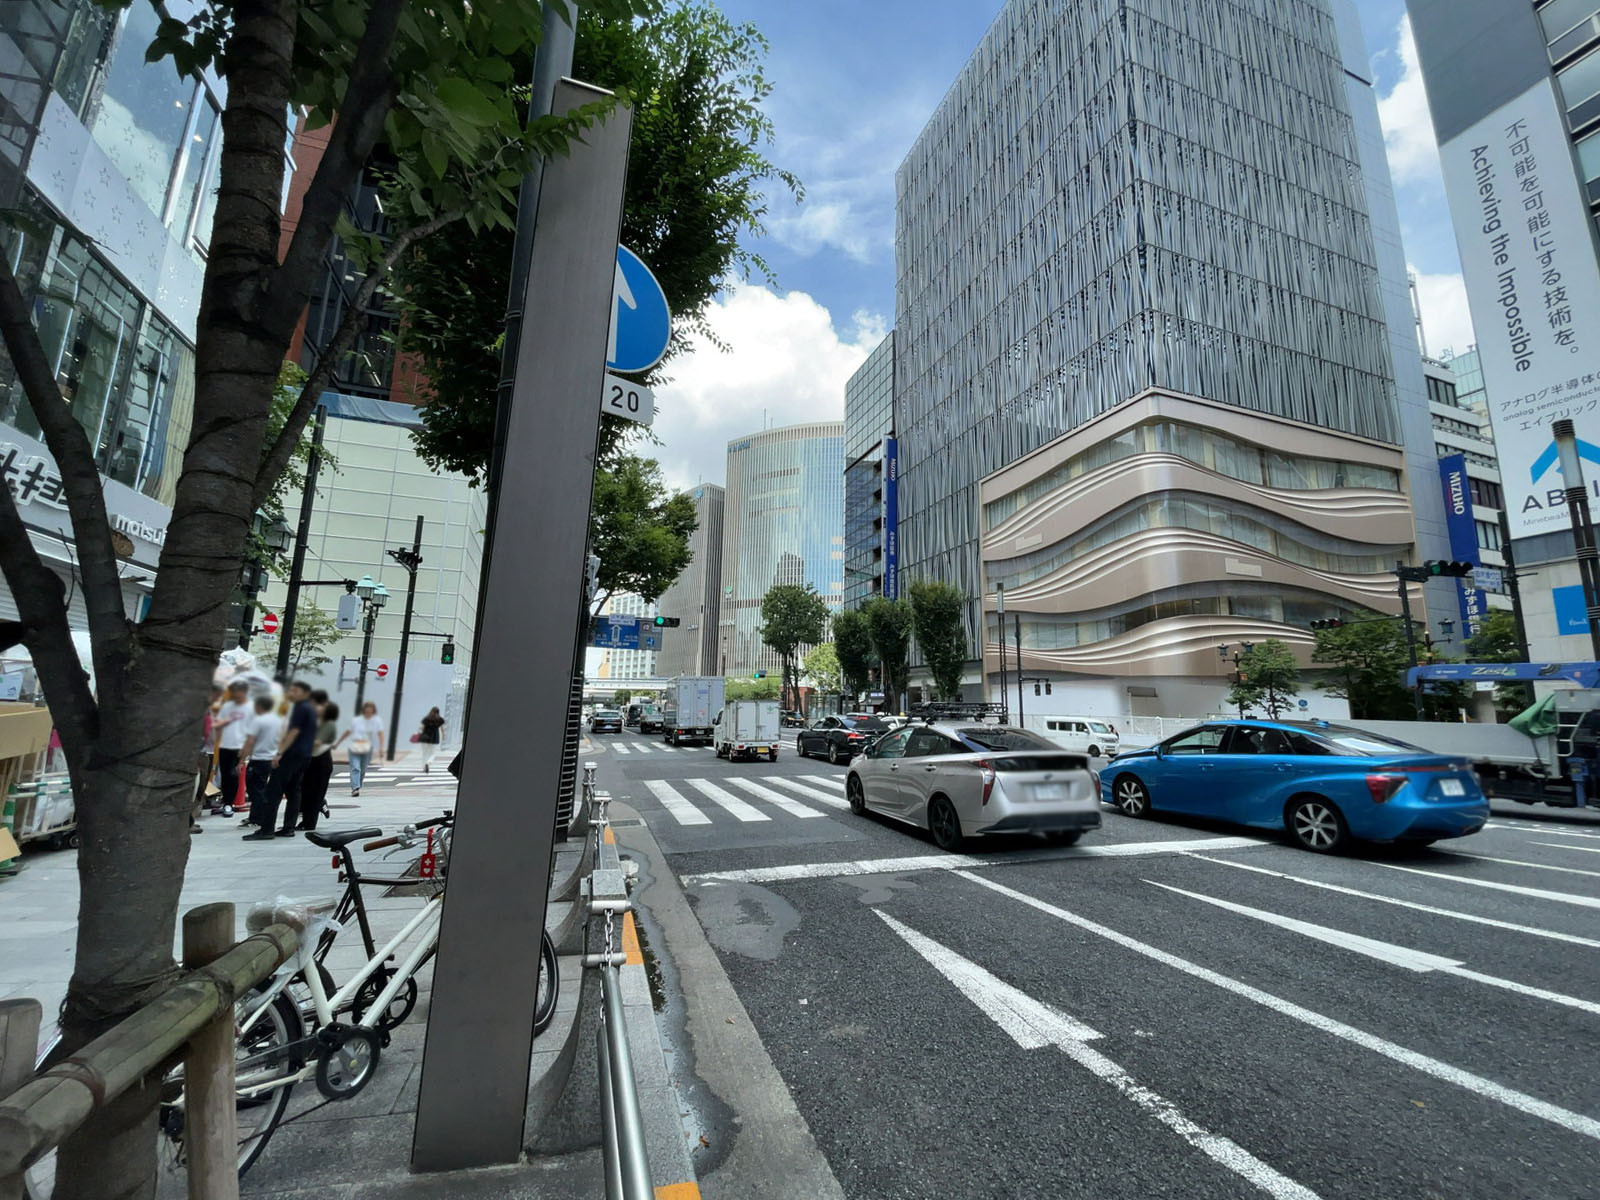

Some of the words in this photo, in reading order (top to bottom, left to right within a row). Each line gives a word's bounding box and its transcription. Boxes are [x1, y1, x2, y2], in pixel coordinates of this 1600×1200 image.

[1470, 144, 1502, 236] Achieving
[1490, 234, 1510, 265] the
[1506, 118, 1579, 355] 不可能を可能にする技術を。
[1497, 266, 1534, 372] Impossible
[611, 385, 639, 412] 20
[1503, 406, 1535, 422] analog
[0, 449, 68, 505] トキヨ
[1449, 471, 1466, 516] MIZUHO
[1521, 479, 1600, 514] ABI
